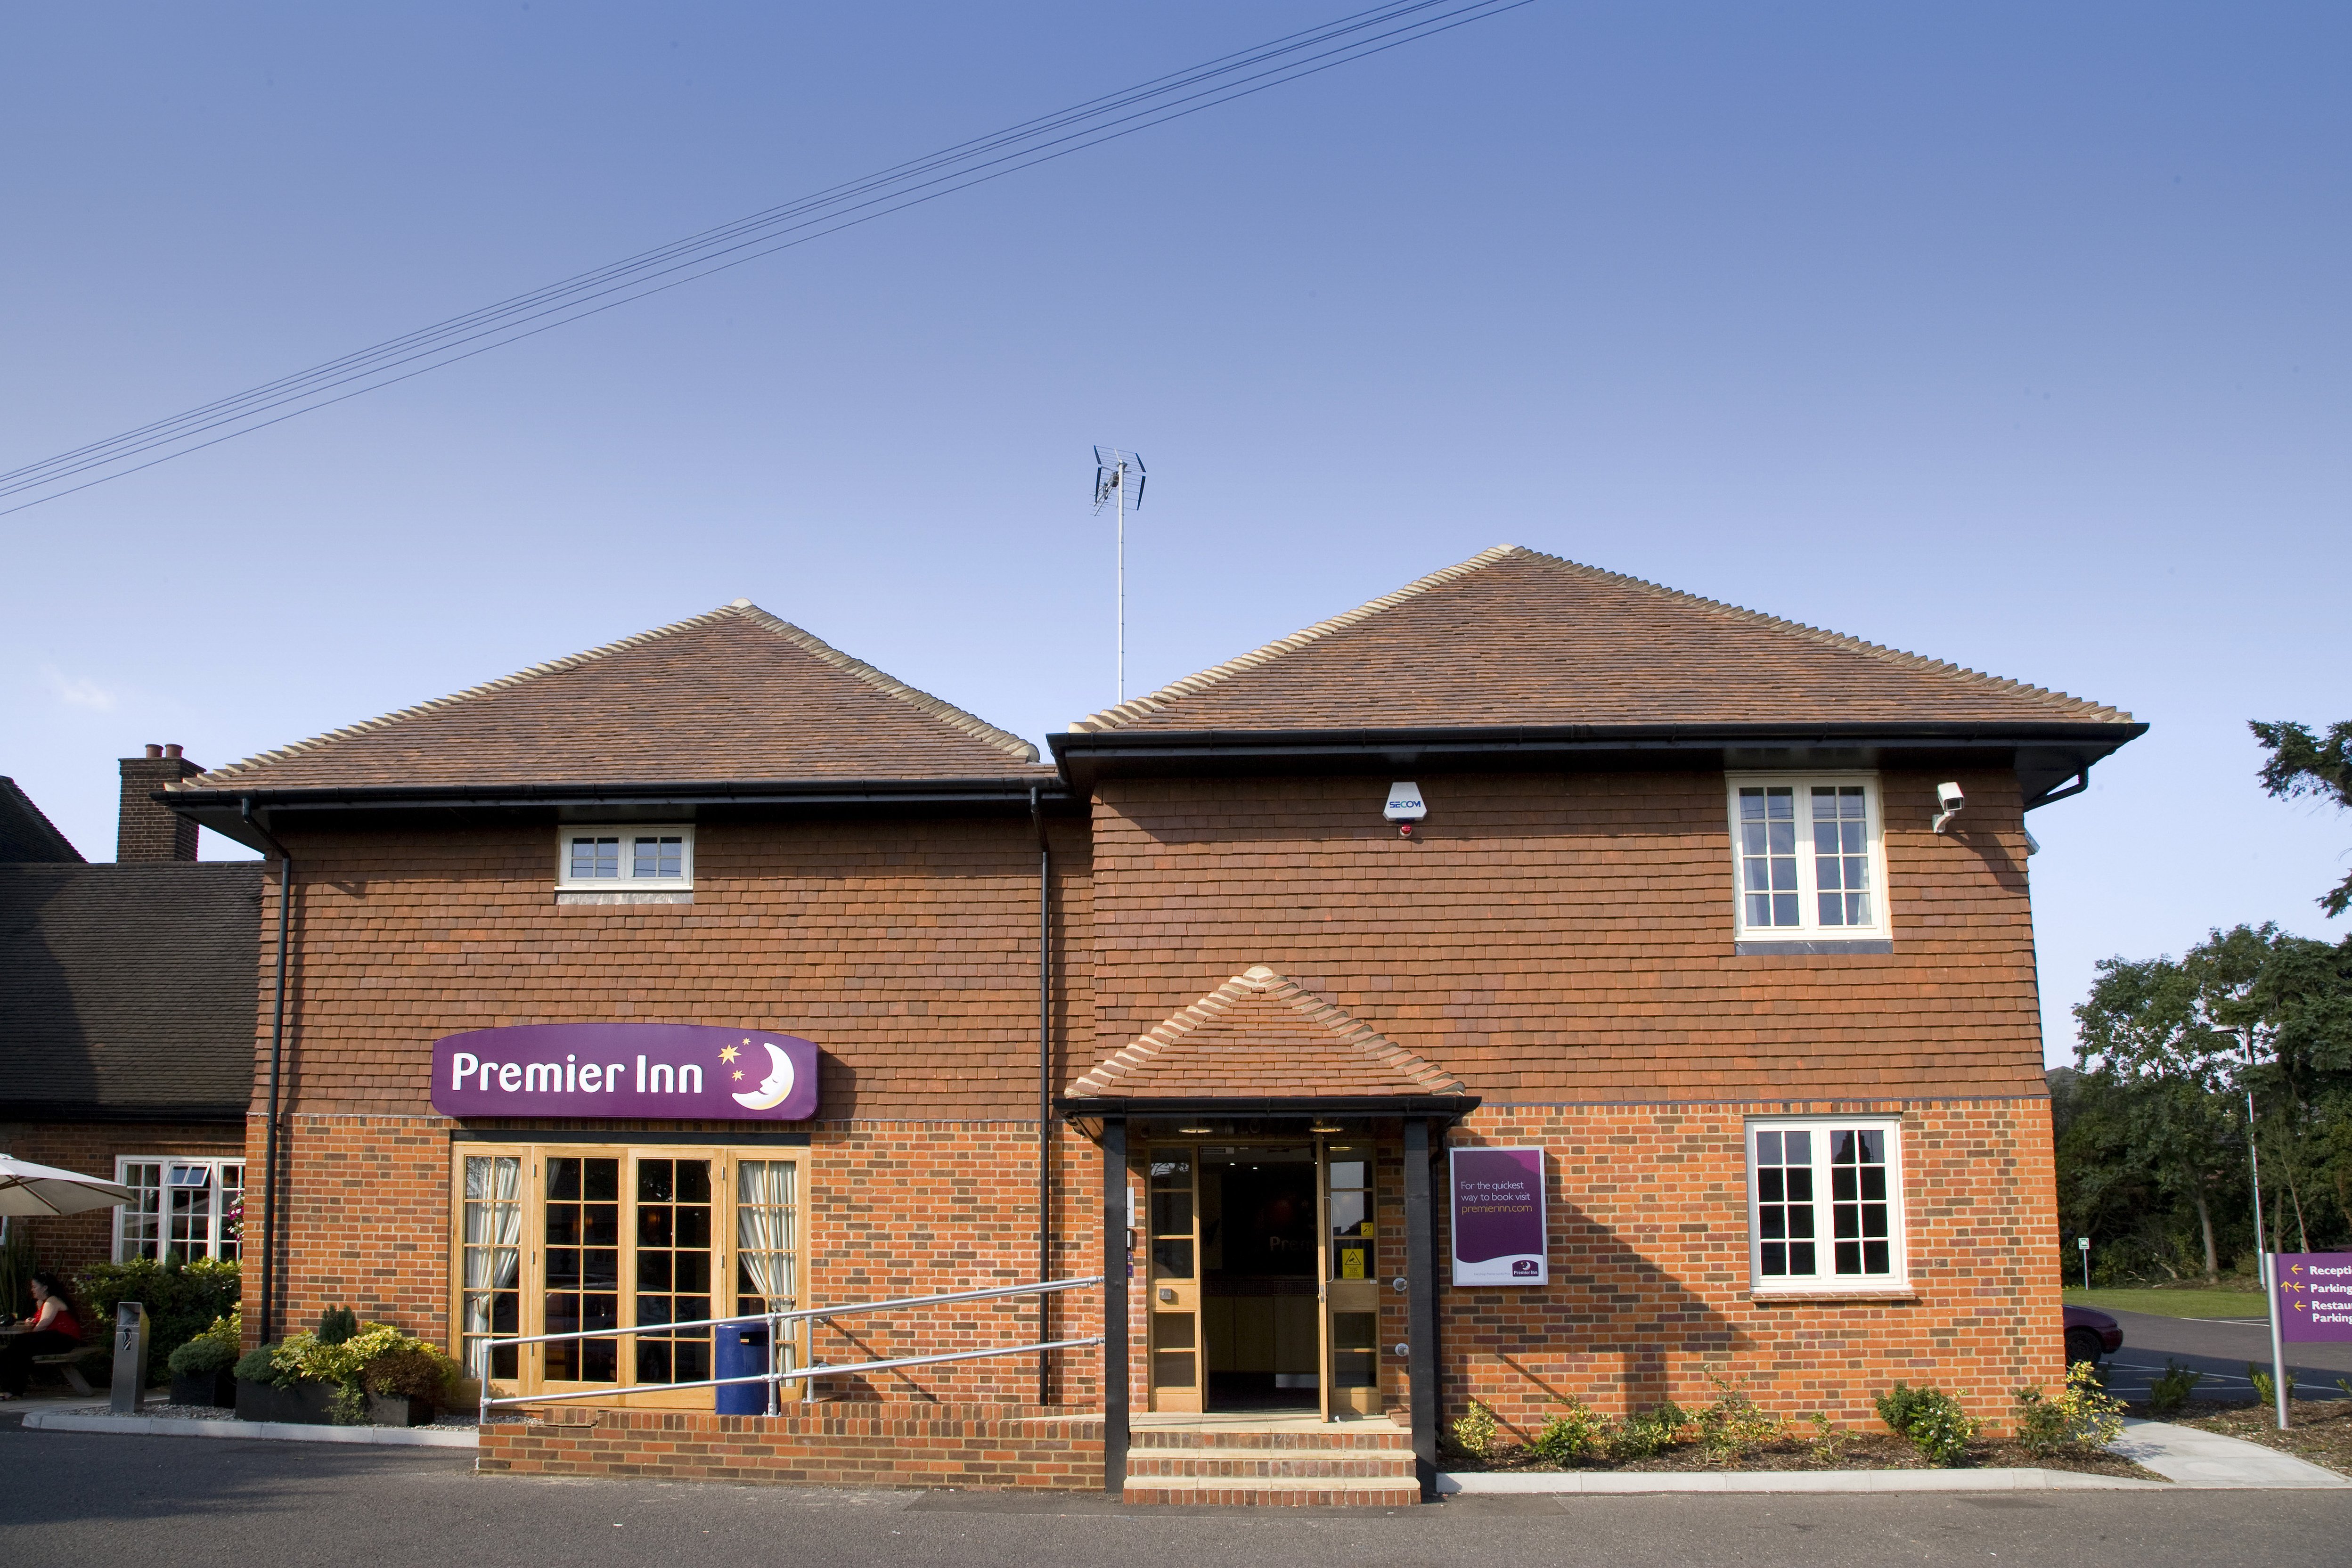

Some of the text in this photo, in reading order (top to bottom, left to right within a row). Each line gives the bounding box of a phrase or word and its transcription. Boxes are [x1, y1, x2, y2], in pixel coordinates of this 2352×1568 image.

[452, 1053, 702, 1093] Premier Inn
[1461, 1181, 1524, 1191] For the quickest
[1461, 1195, 1478, 1203] way
[1492, 1192, 1513, 1201] book
[1515, 1192, 1531, 1200] visit
[1462, 1203, 1532, 1215] premierinn.com
[2310, 1266, 2352, 1277] Recepti
[2311, 1283, 2352, 1295] Parking
[2311, 1300, 2352, 1310] Restau
